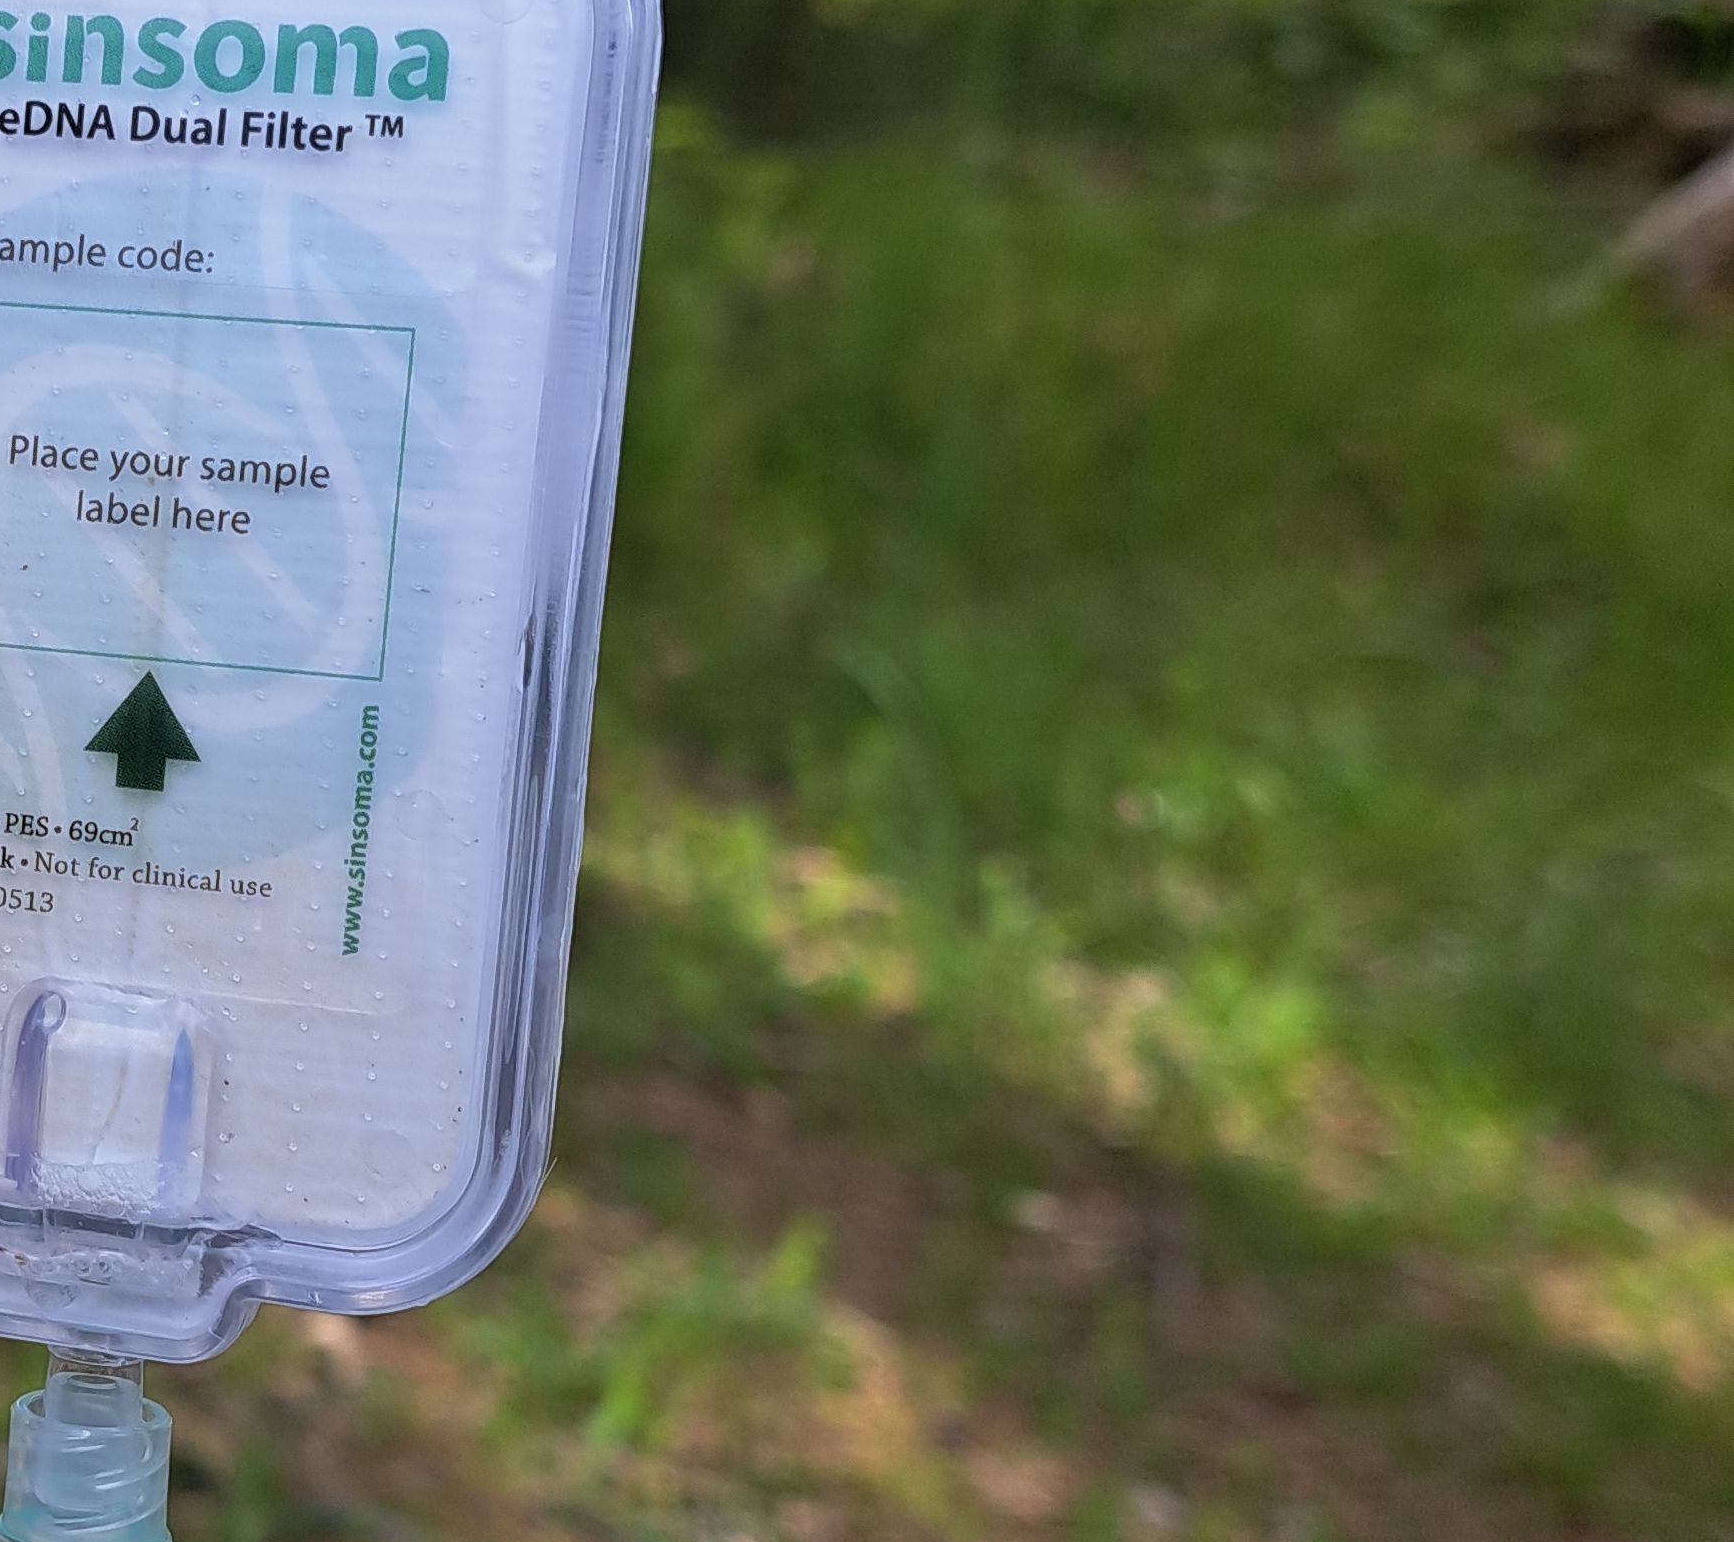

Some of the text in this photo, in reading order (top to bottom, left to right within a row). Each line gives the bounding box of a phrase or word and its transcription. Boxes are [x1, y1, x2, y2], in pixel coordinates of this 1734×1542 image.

[130, 106, 226, 147] Dual
[240, 112, 353, 152] Filter
[118, 239, 215, 274] code:
[9, 435, 331, 493] Place your sample
[76, 490, 252, 535] label here
[4, 812, 50, 838] PES
[341, 704, 380, 956] www.sinsoma.com
[33, 852, 79, 877] Not
[87, 857, 125, 882] for
[132, 862, 222, 893] clinical
[229, 877, 273, 899] use
